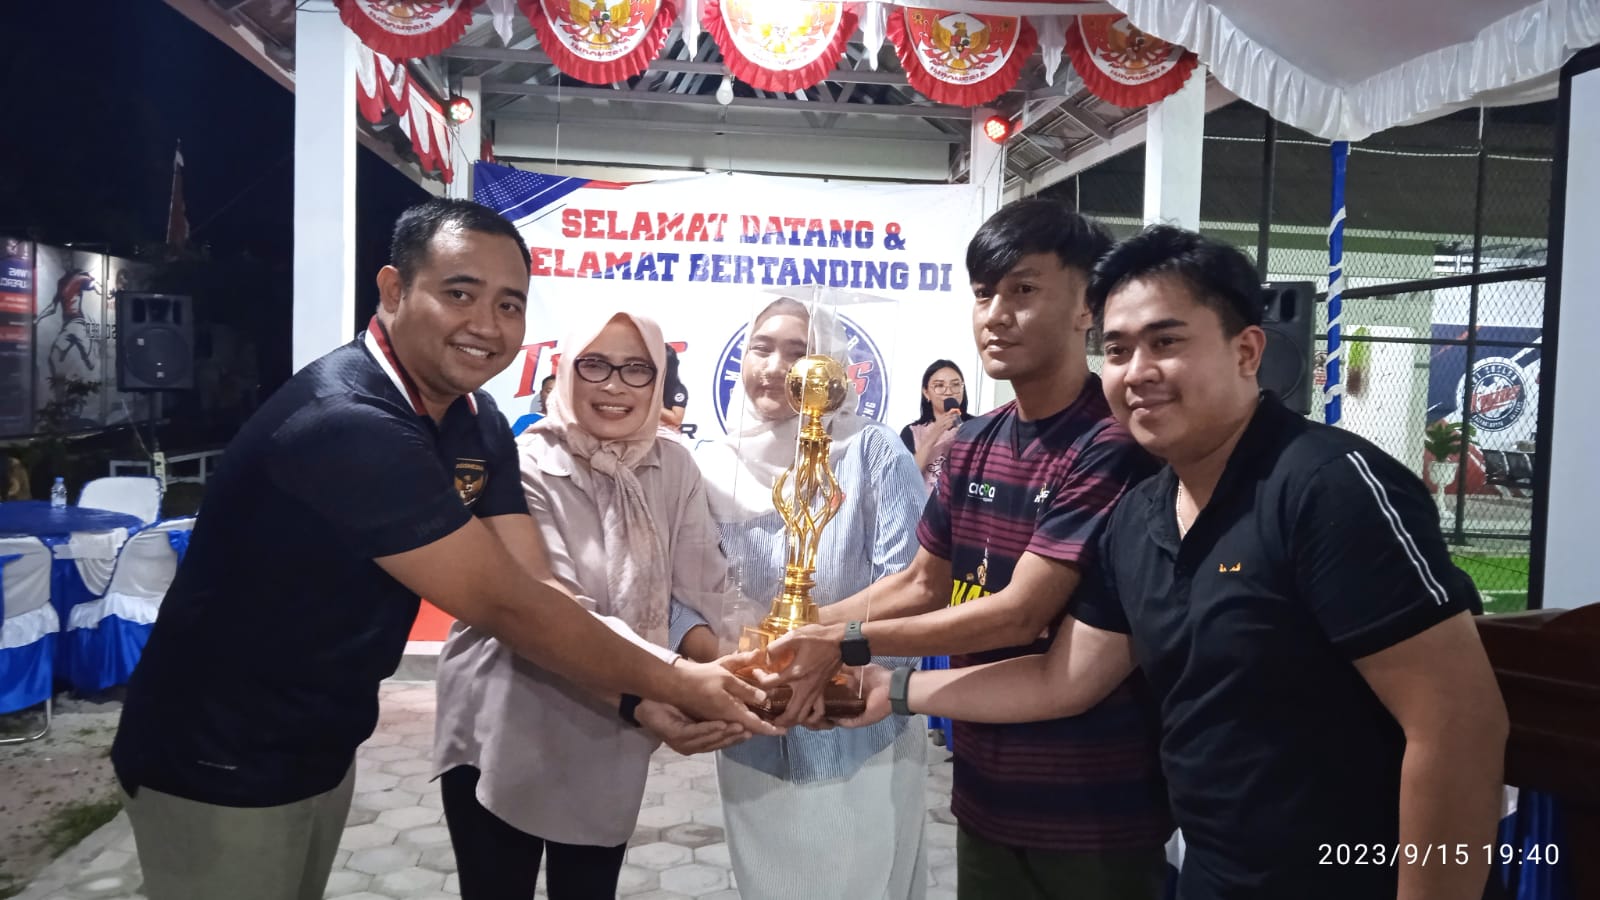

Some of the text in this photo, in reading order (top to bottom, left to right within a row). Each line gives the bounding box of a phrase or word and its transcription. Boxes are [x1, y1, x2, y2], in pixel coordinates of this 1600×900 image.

[562, 208, 906, 250] SELAMAT DATANG &
[531, 247, 952, 291] ELAMAT BERTANDING DI
